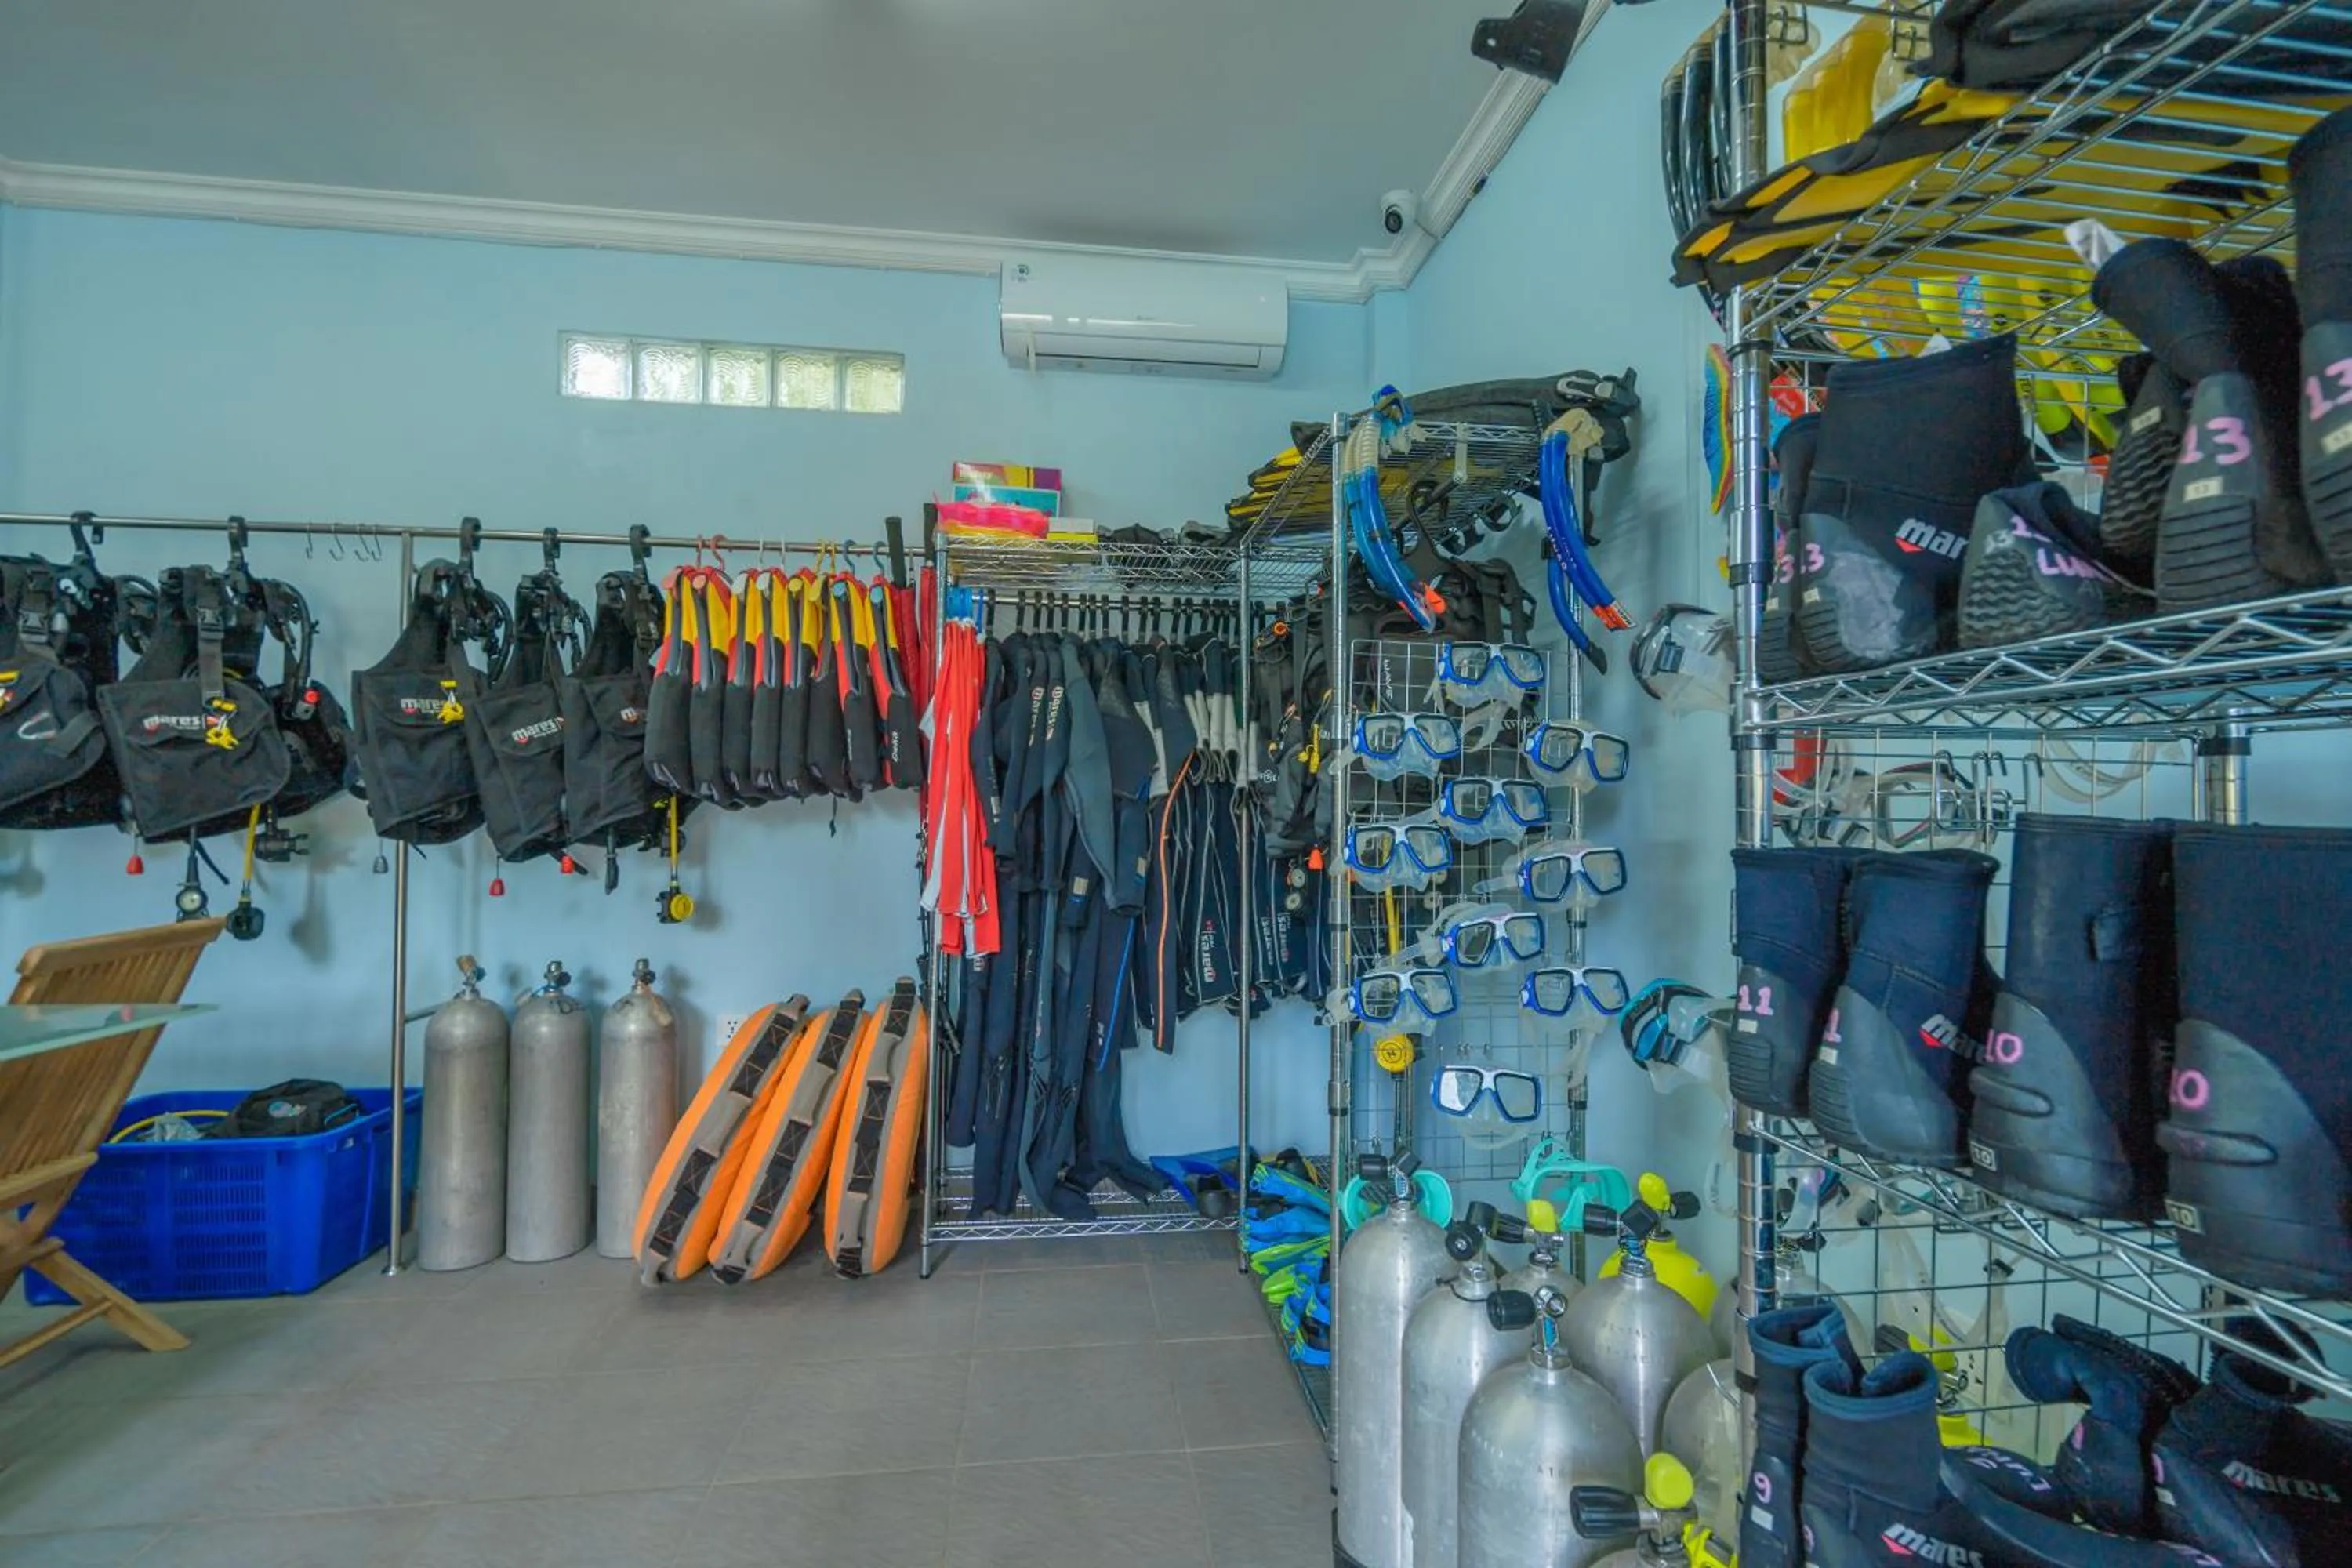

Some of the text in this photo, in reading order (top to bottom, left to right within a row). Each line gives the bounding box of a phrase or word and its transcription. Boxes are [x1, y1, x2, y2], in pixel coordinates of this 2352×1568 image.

[2178, 416, 2252, 465] 13
[1894, 517, 1969, 560] mar
[1737, 984, 1774, 1016] 11
[1985, 1028, 2024, 1064] 10
[1754, 1471, 1772, 1504] 9
[2221, 1460, 2342, 1504] mares
